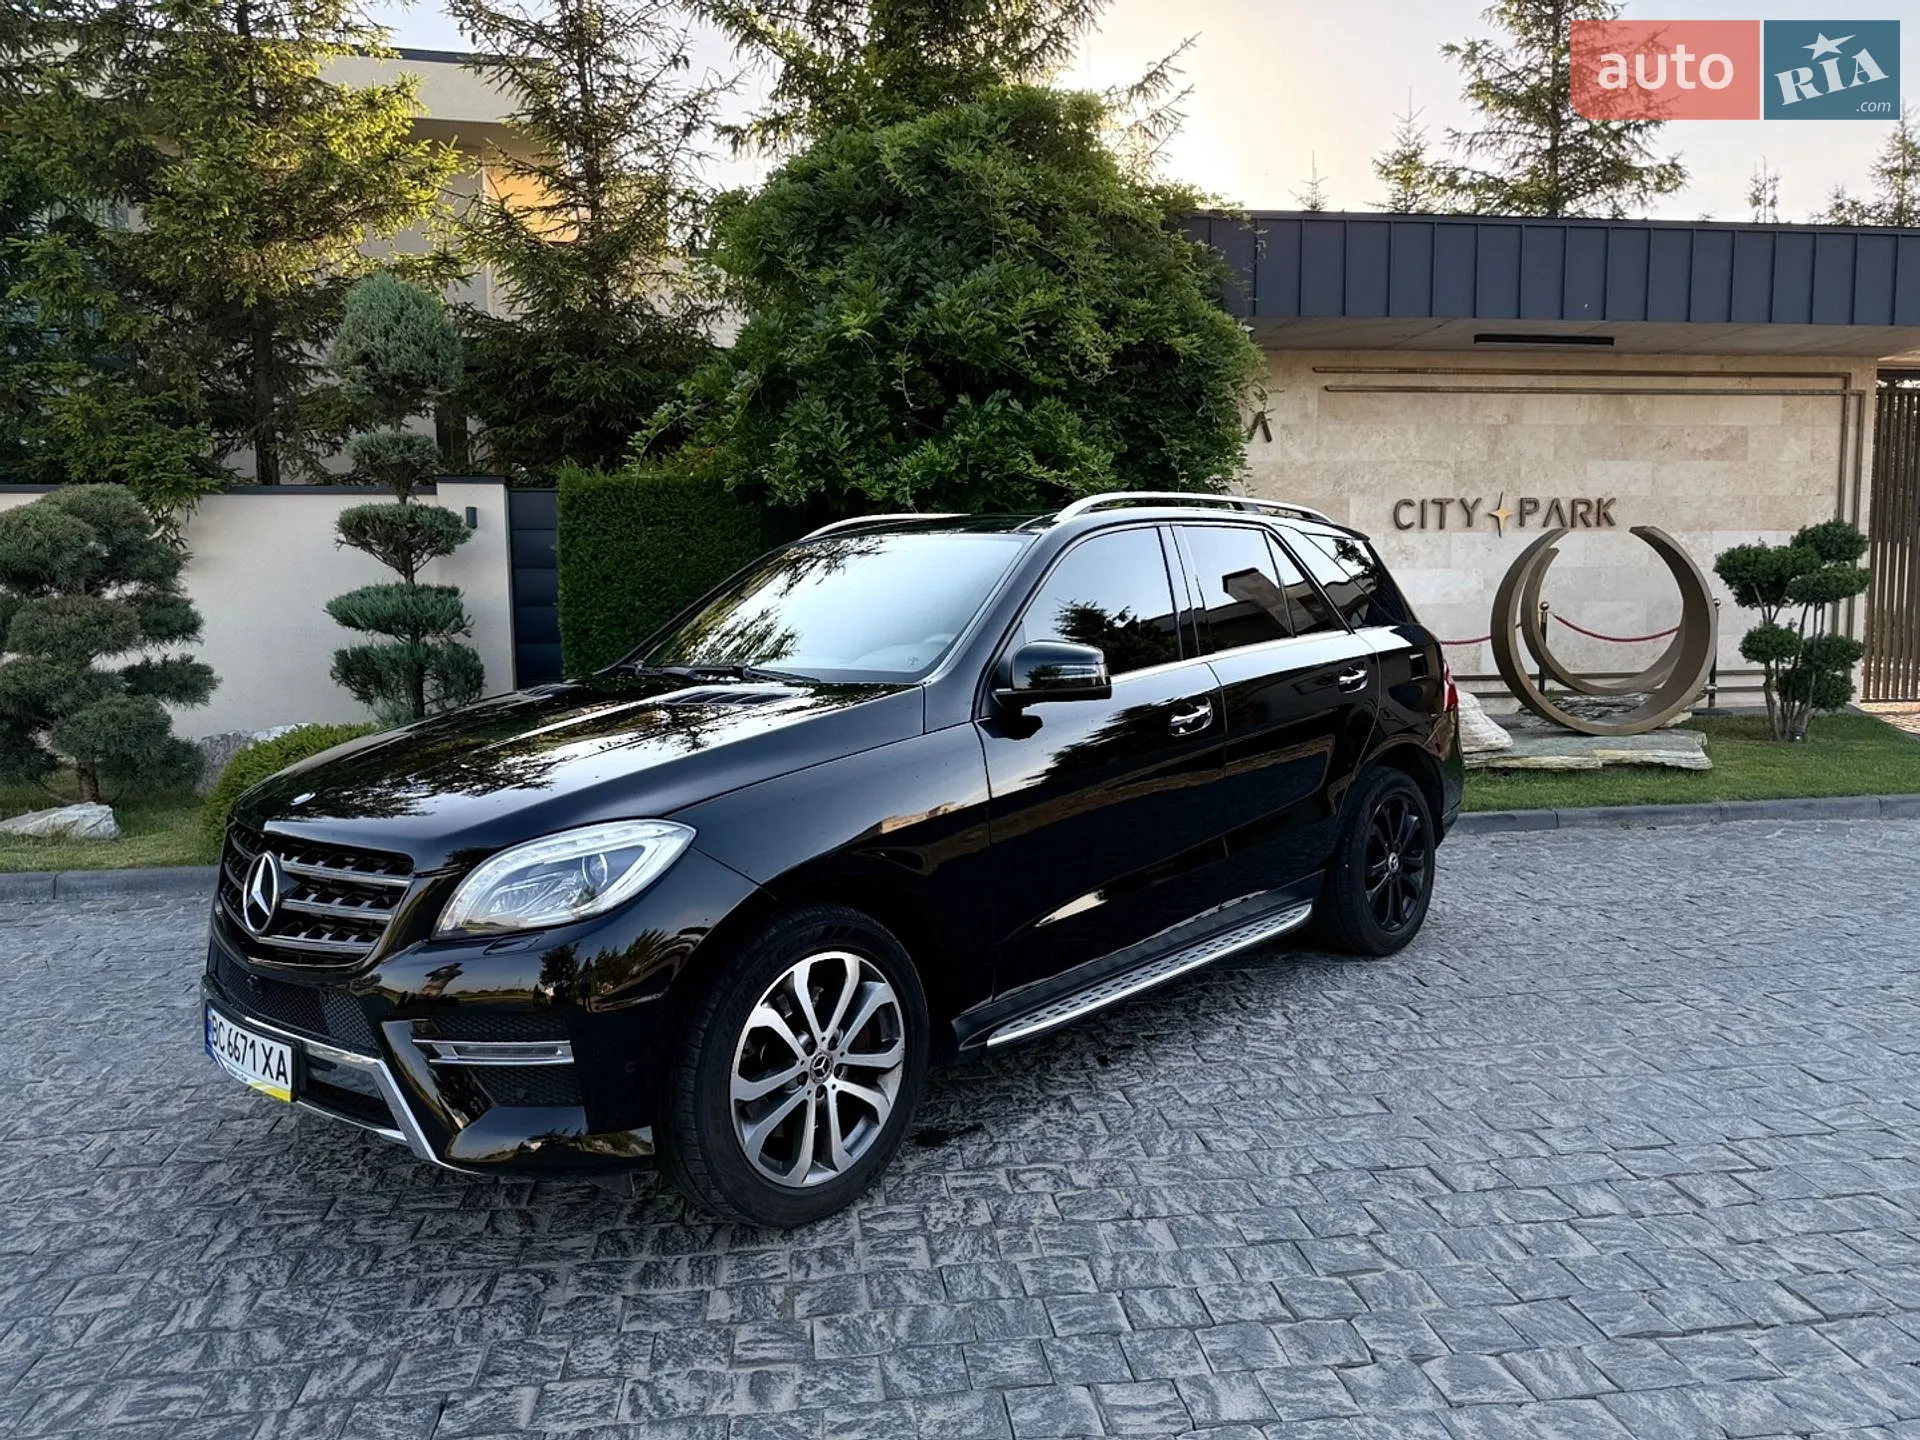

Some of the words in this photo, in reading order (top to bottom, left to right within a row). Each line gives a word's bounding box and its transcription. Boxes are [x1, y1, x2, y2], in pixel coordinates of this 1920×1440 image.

[1393, 497, 1482, 530] CITY
[1518, 497, 1617, 529] PARK
[227, 1027, 256, 1072] 6671
[261, 1042, 289, 1085] XA
